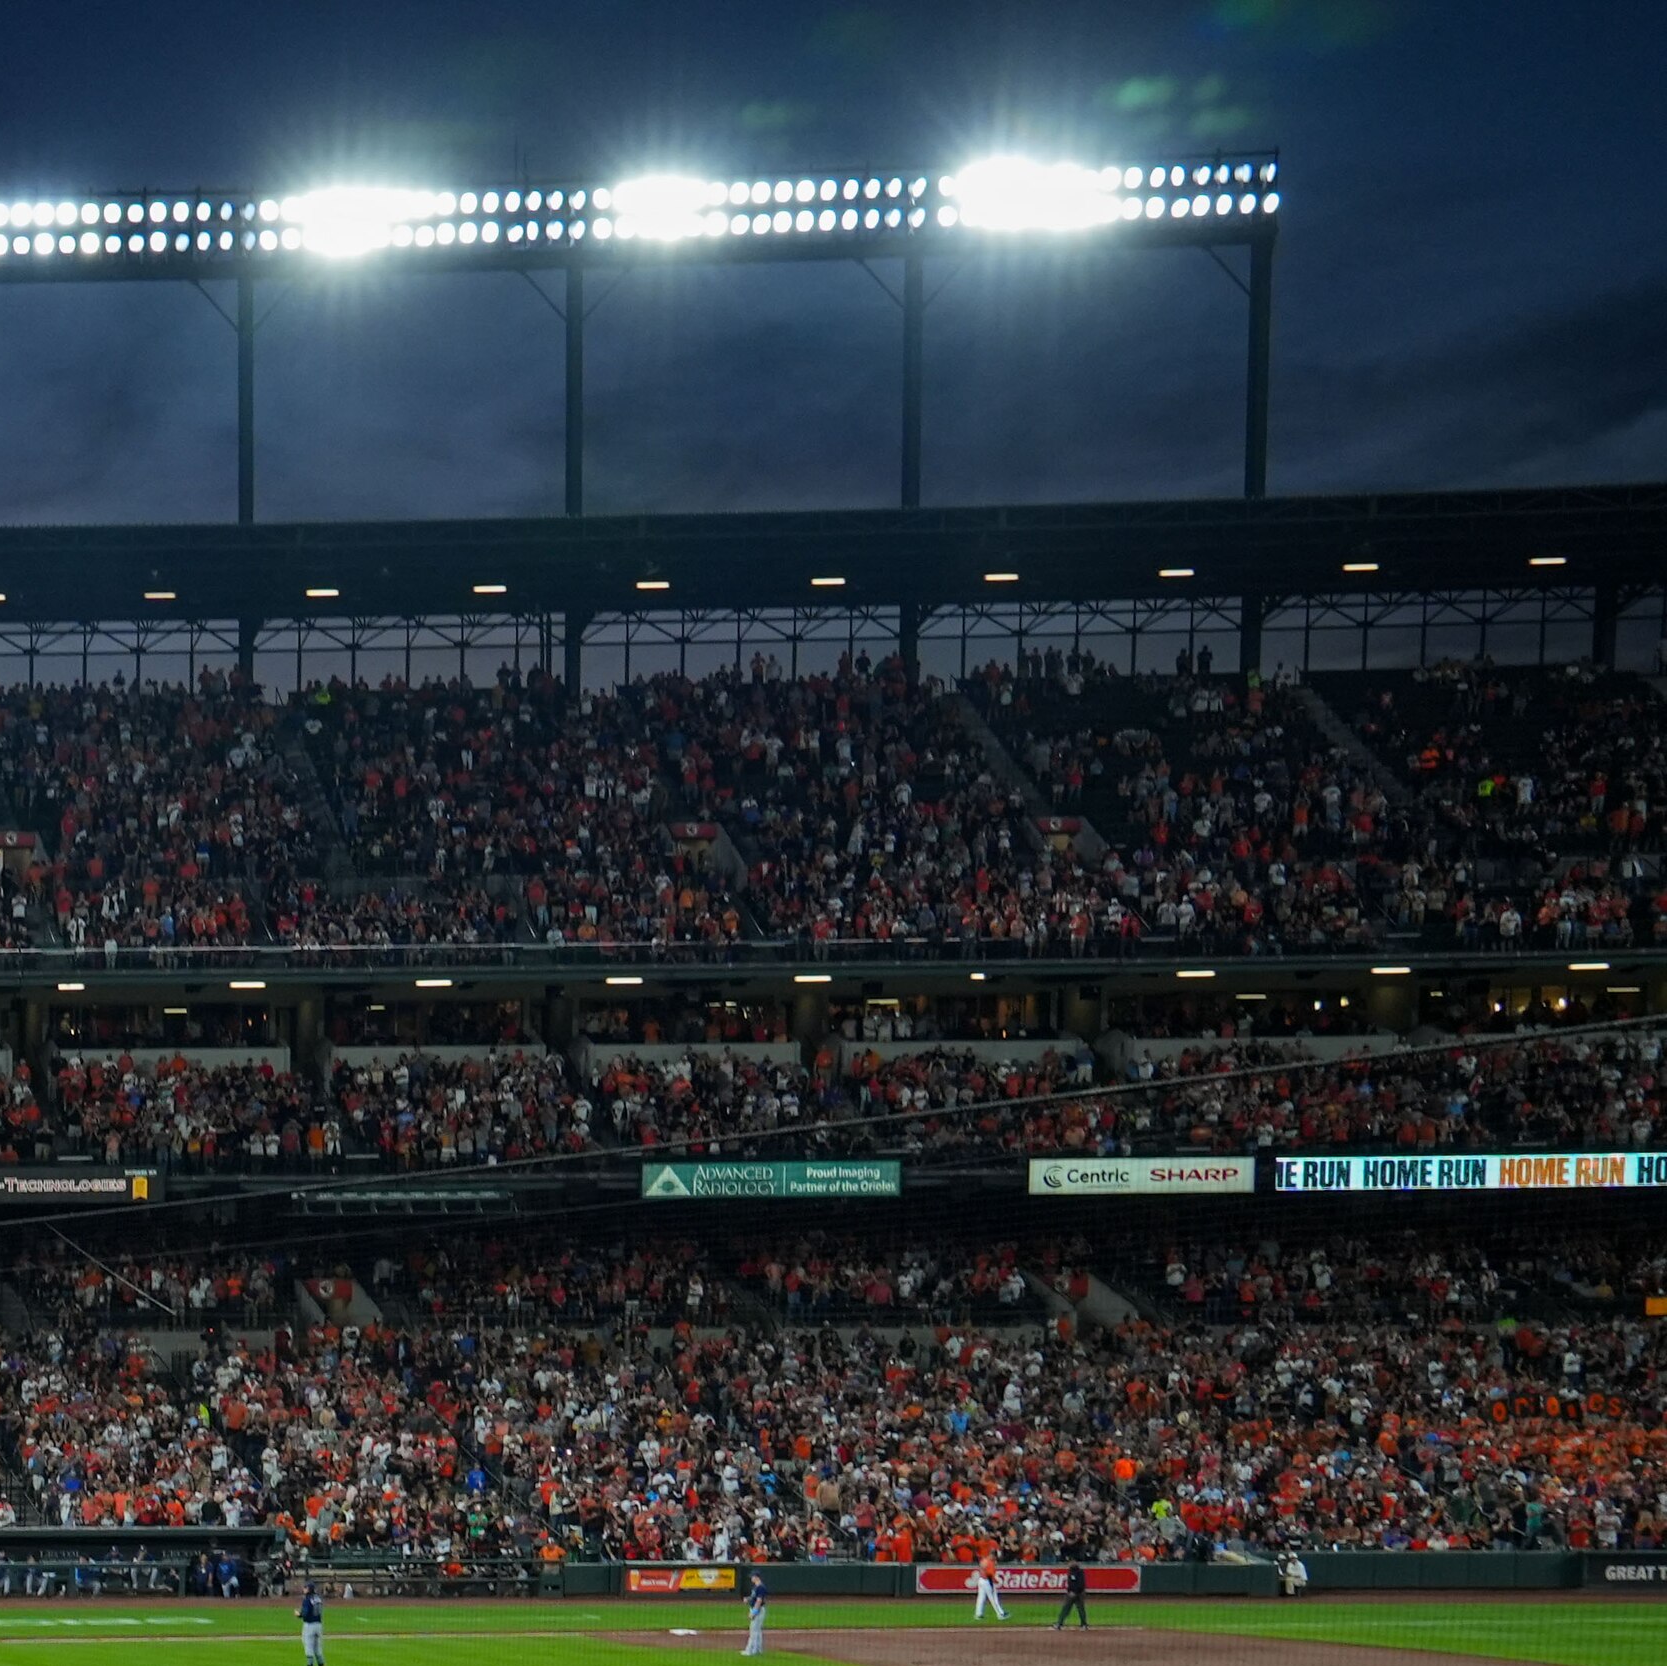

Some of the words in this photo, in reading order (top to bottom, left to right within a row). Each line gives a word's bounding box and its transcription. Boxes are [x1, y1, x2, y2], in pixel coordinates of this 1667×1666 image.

[696, 1165, 773, 1180] ADVANCED
[806, 1166, 837, 1179] Proud
[838, 1167, 881, 1180] Imaging
[1067, 1167, 1130, 1184] Centric
[1149, 1168, 1239, 1182] SHARP
[1302, 1160, 1352, 1188] RUN
[1362, 1159, 1433, 1188] HOME
[1437, 1158, 1487, 1187] RUN
[1499, 1157, 1570, 1187] HOME
[1574, 1156, 1626, 1186] RUN
[693, 1180, 777, 1196] RADIOLOGY
[790, 1181, 828, 1193] Partner
[841, 1181, 859, 1193] the
[859, 1180, 897, 1193] Orioles
[995, 1569, 1039, 1590] State
[1038, 1570, 1070, 1590] Far
[1605, 1565, 1654, 1580] GREAT
